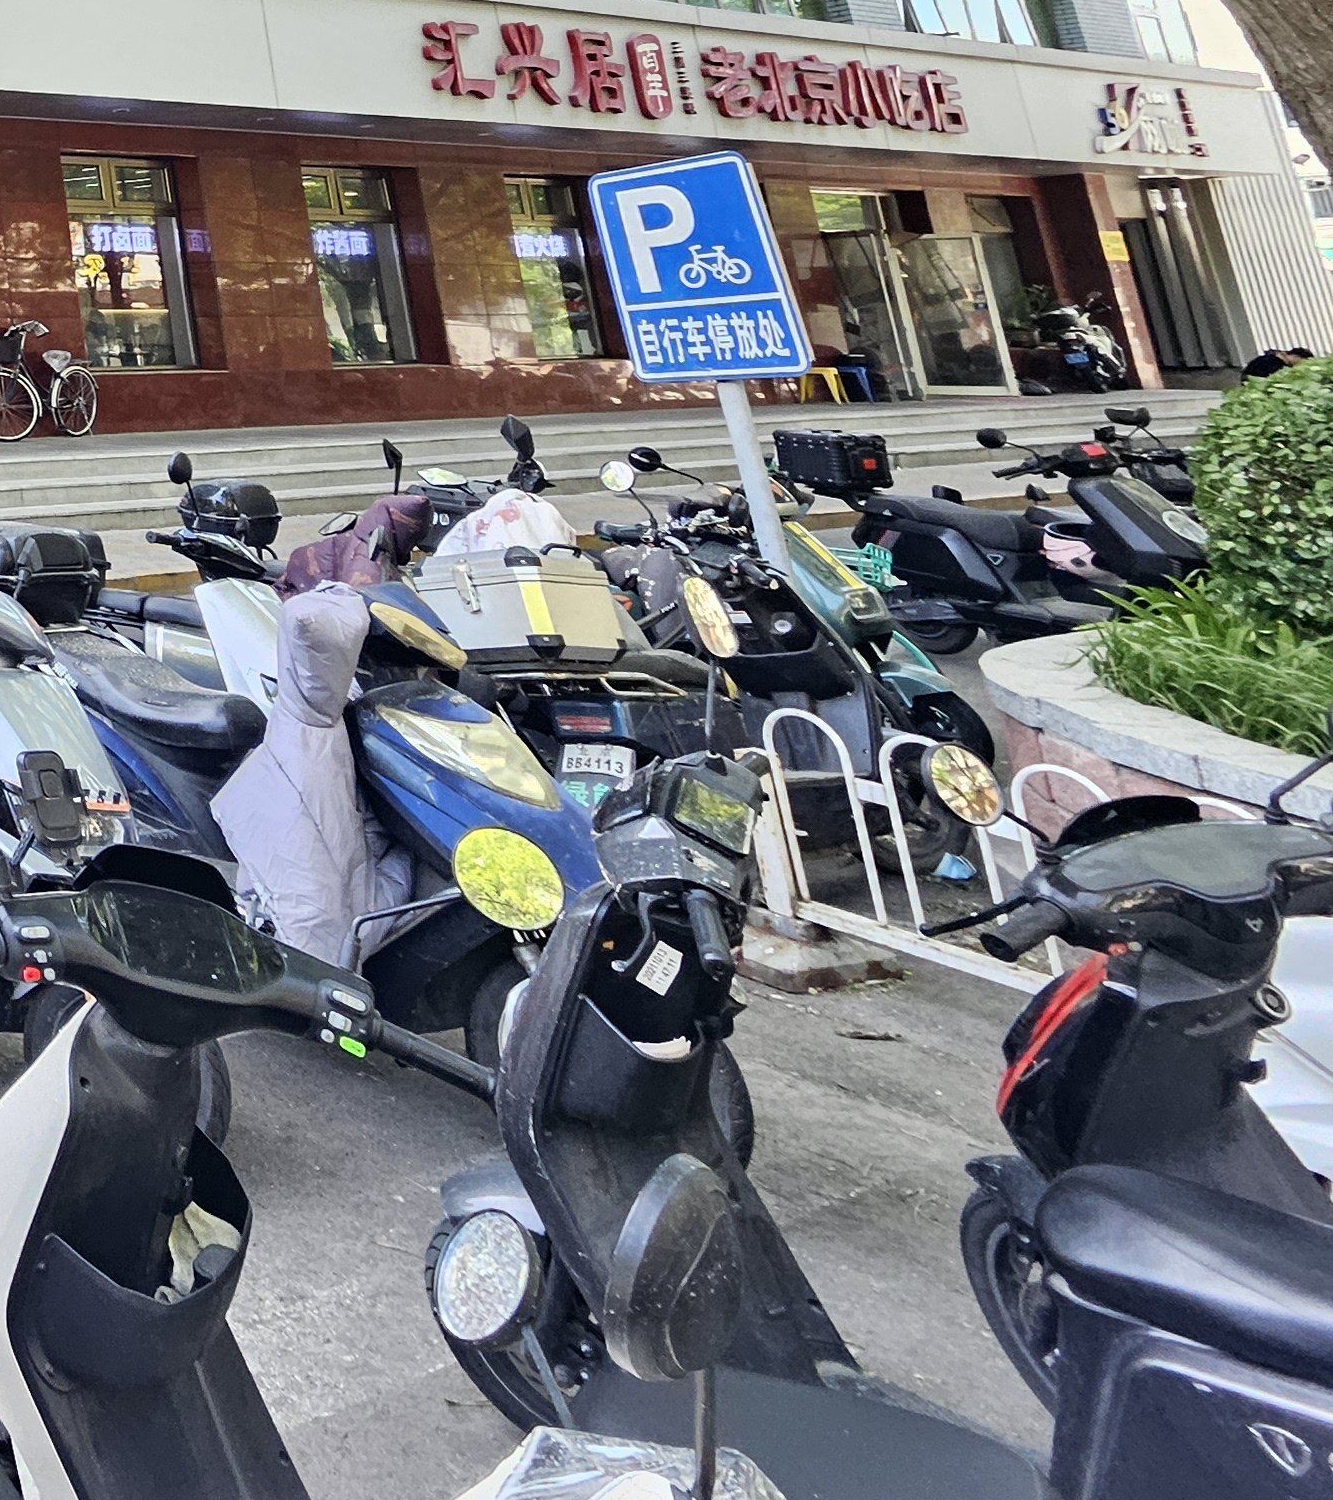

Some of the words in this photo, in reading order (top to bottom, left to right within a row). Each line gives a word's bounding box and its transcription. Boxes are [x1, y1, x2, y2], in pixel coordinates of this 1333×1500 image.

[422, 20, 626, 114] 汇兴居
[700, 45, 969, 134] 老北京小吃店
[91, 224, 156, 253] 打卤面
[615, 184, 696, 294] P
[637, 309, 792, 365] 自行车停放处
